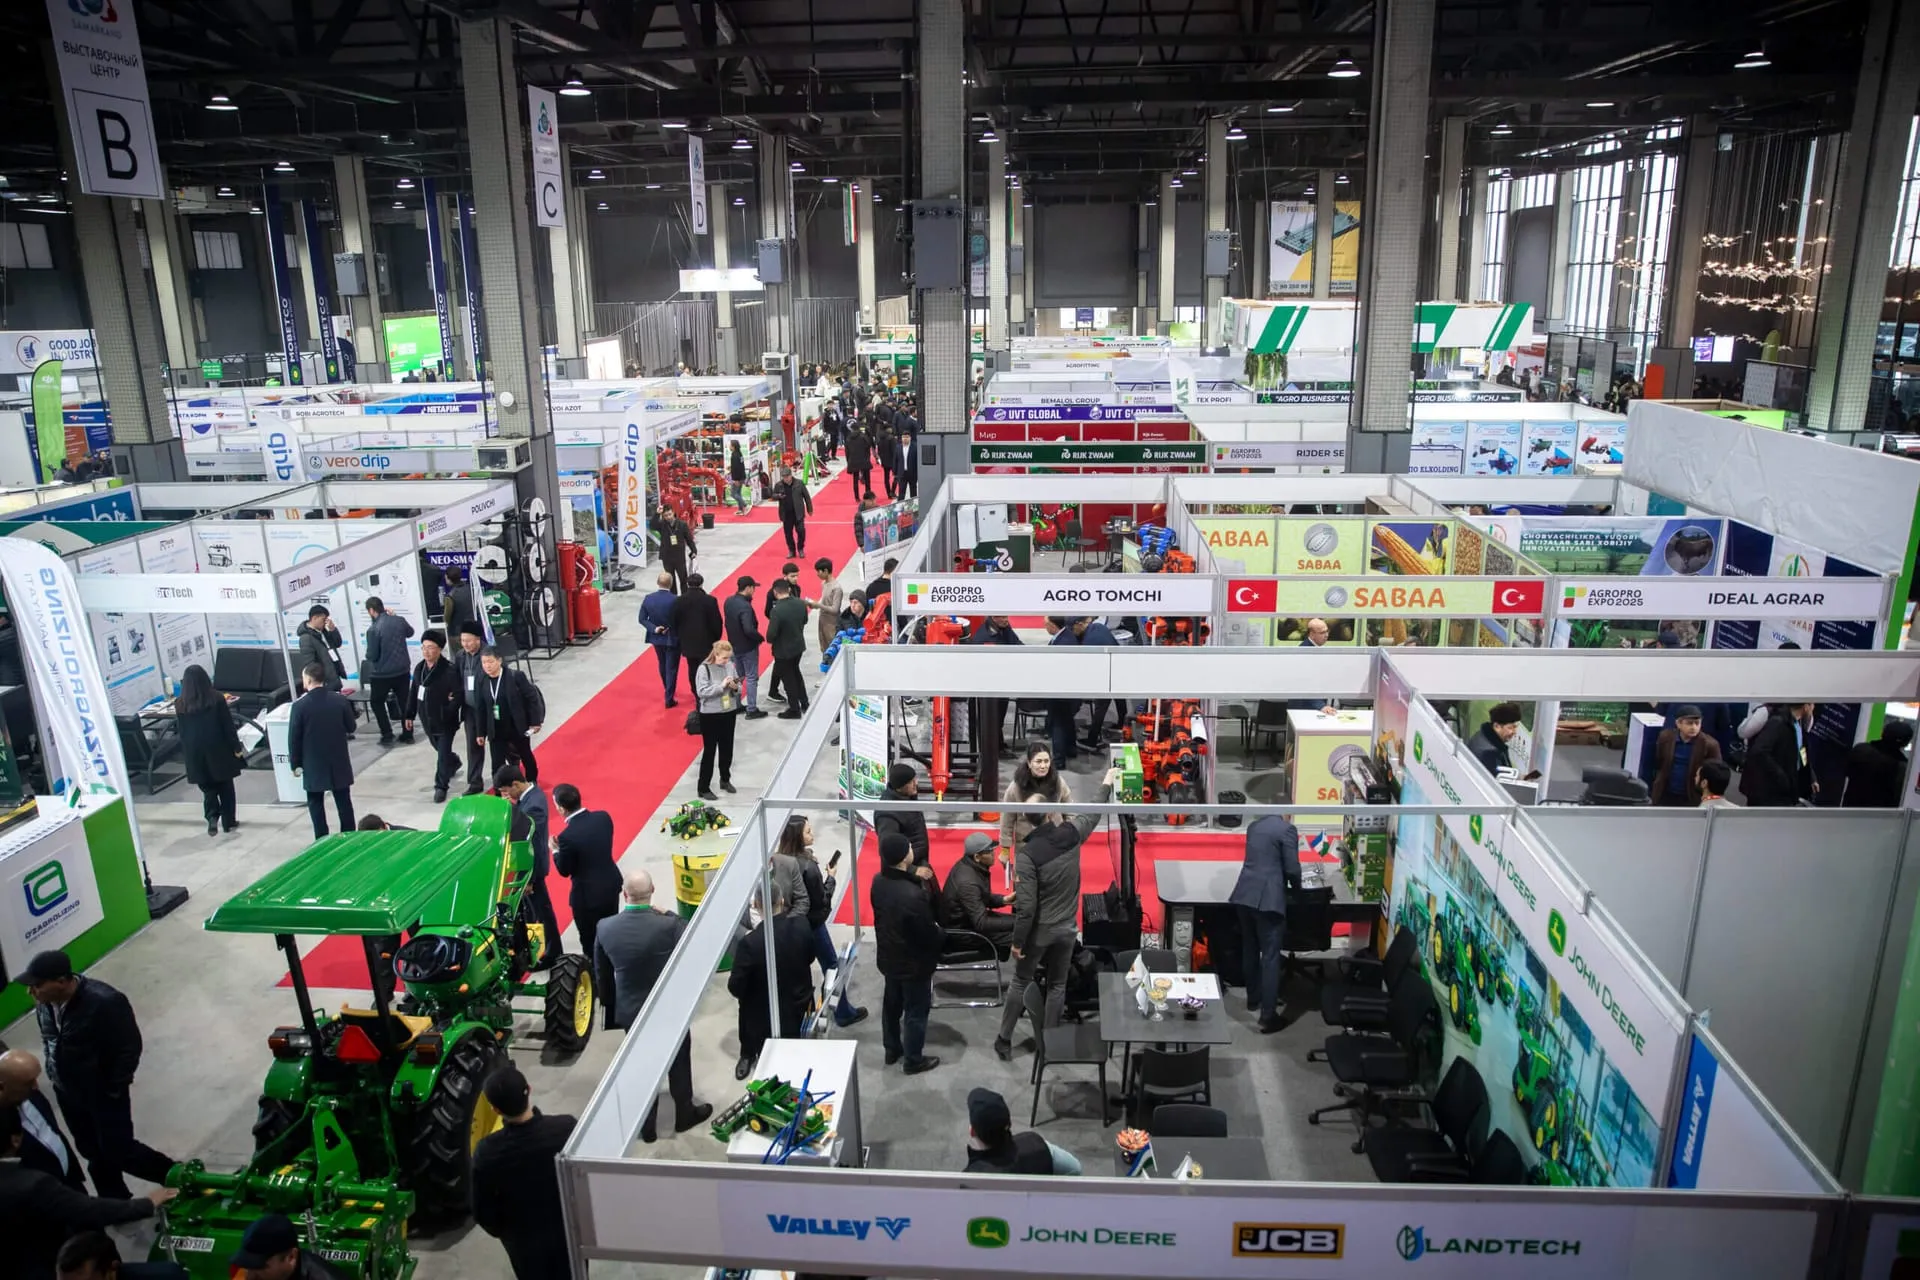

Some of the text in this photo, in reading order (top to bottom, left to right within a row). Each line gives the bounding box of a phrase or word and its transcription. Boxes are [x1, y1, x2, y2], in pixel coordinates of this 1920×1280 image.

[63, 41, 139, 68] ВЫСТАВОЧНЫЙ
[90, 64, 120, 79] ЦЕНТР
[96, 109, 138, 180] B
[544, 182, 558, 218] C
[696, 201, 705, 228] D
[282, 298, 296, 363] MOBETCO
[318, 296, 332, 358] MOBETCO
[437, 294, 451, 359] MOBETCO
[49, 340, 76, 350] GOOD
[1008, 409, 1062, 420] UVT GLOBAL
[1105, 408, 1122, 419] UVT
[980, 432, 997, 440] Мир
[325, 454, 390, 469] verodrip
[1202, 530, 1268, 546] ABAA
[430, 555, 476, 564] NEO-SMA
[1297, 560, 1341, 570] SABAA
[931, 594, 984, 603] EXPO2025
[932, 586, 982, 595] AGROPRO
[1043, 590, 1161, 602] AGRO TOMCHI
[1354, 587, 1445, 608] SABAA
[1589, 589, 1642, 598] AGROPRO
[1588, 598, 1644, 606] EXPO2025
[1708, 593, 1824, 606] IDEAL AGRAR
[1424, 752, 1441, 783] JOHN
[1317, 788, 1342, 800] SA
[1484, 834, 1537, 912] JOHN DEERE
[1568, 946, 1646, 1056] JOHN DEERE
[766, 1214, 870, 1240] VALLEY
[1020, 1225, 1177, 1246] JOHN DEERE
[1240, 1229, 1336, 1252] JCB
[1425, 1238, 1582, 1256] LANDTECH
